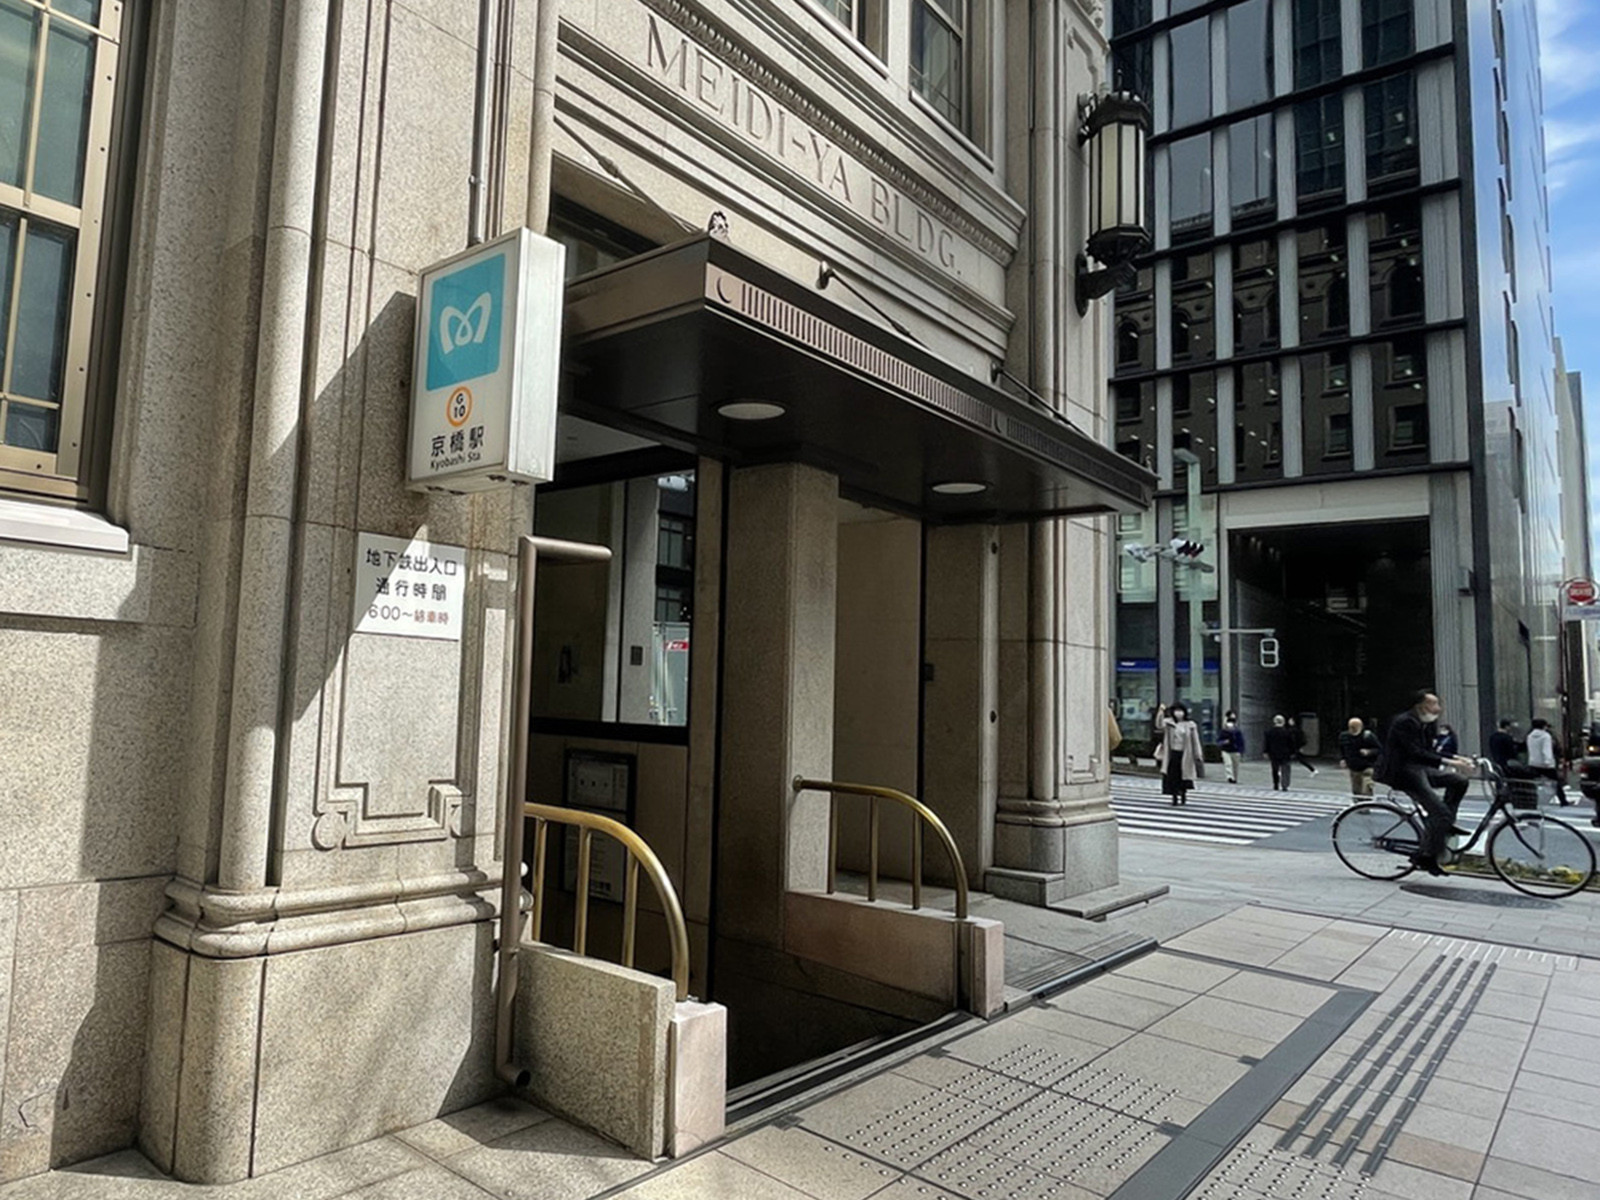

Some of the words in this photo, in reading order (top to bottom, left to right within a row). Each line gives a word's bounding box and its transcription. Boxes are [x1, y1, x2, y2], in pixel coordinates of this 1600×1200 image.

[647, 13, 852, 204] MEIDI-YA
[869, 176, 962, 275] BLDG.
[454, 405, 466, 418] 10
[455, 393, 464, 404] G
[431, 426, 484, 457] 京橋駅
[365, 547, 457, 576] 地下鉄出入口
[375, 576, 447, 601] 通行時間
